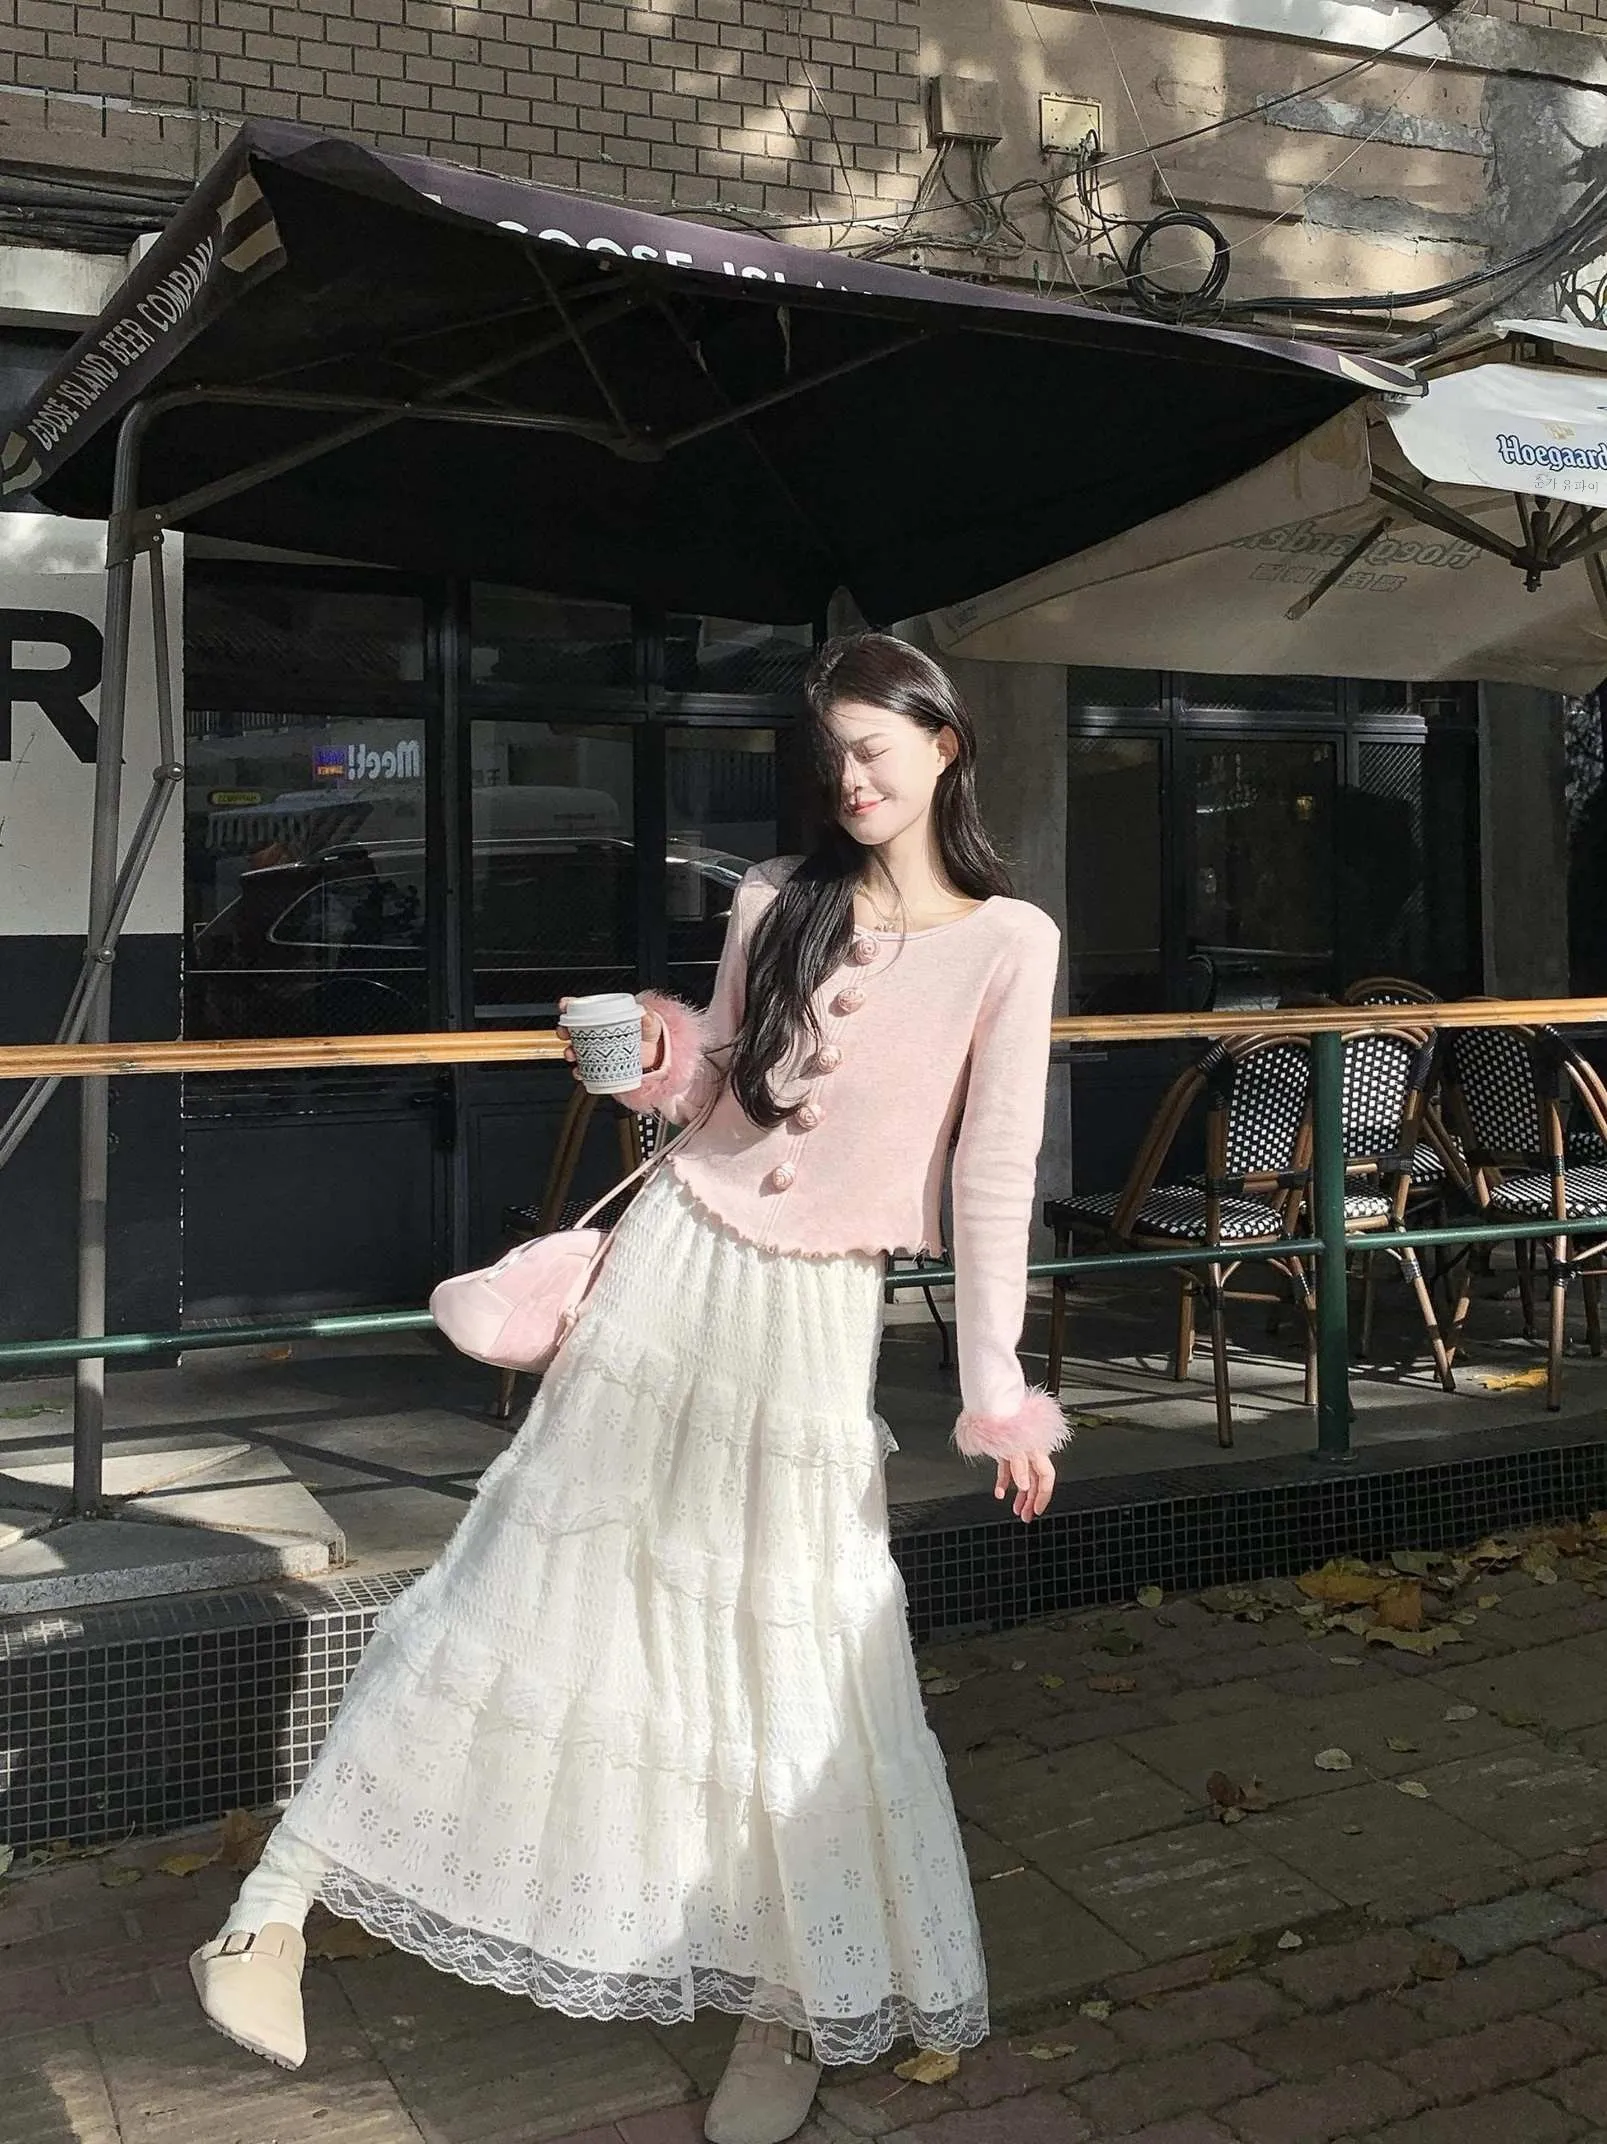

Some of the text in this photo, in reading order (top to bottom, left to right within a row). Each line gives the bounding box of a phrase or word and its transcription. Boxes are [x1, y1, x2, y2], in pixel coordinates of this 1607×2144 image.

[27, 236, 214, 451] GOOSE ISLAND BEER COMPANY
